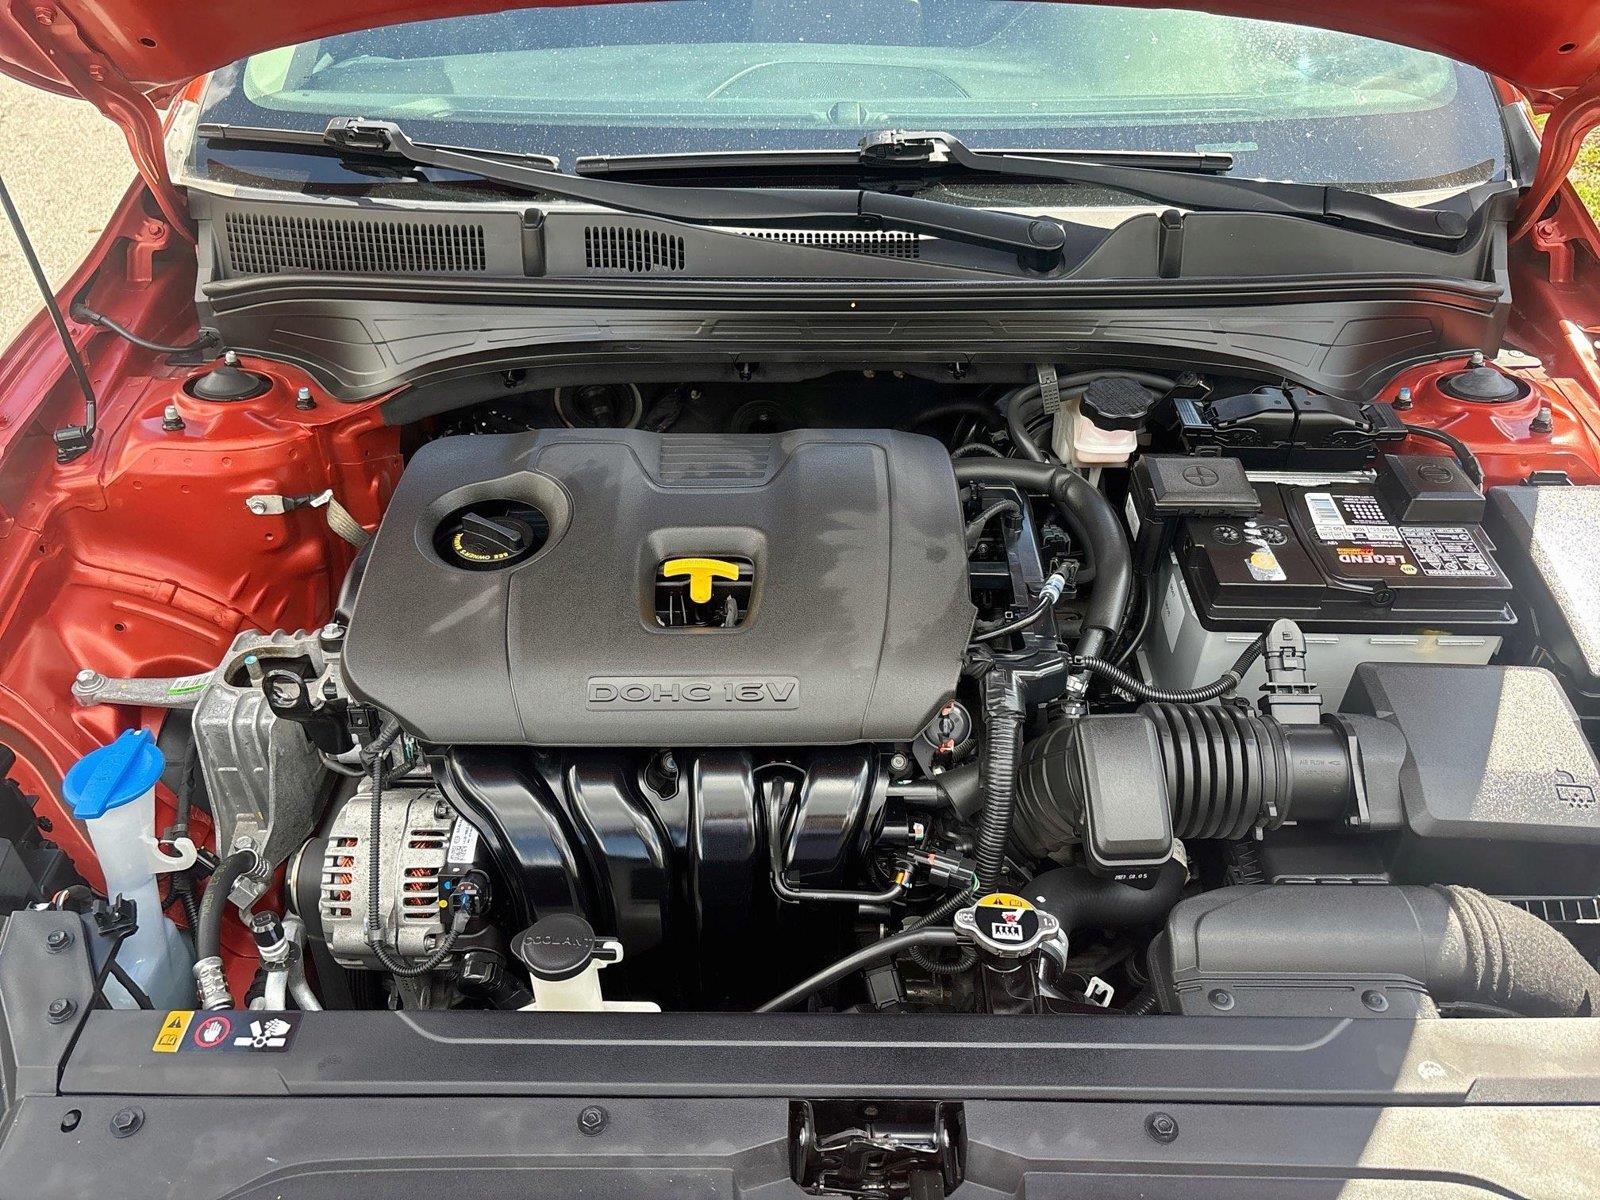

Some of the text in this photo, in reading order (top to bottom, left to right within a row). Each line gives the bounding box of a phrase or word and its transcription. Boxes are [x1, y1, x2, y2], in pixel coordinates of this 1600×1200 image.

[1339, 554, 1406, 564] LEGEND
[588, 683, 796, 702] DOHC 16V
[1043, 917, 1056, 927] 1.1
